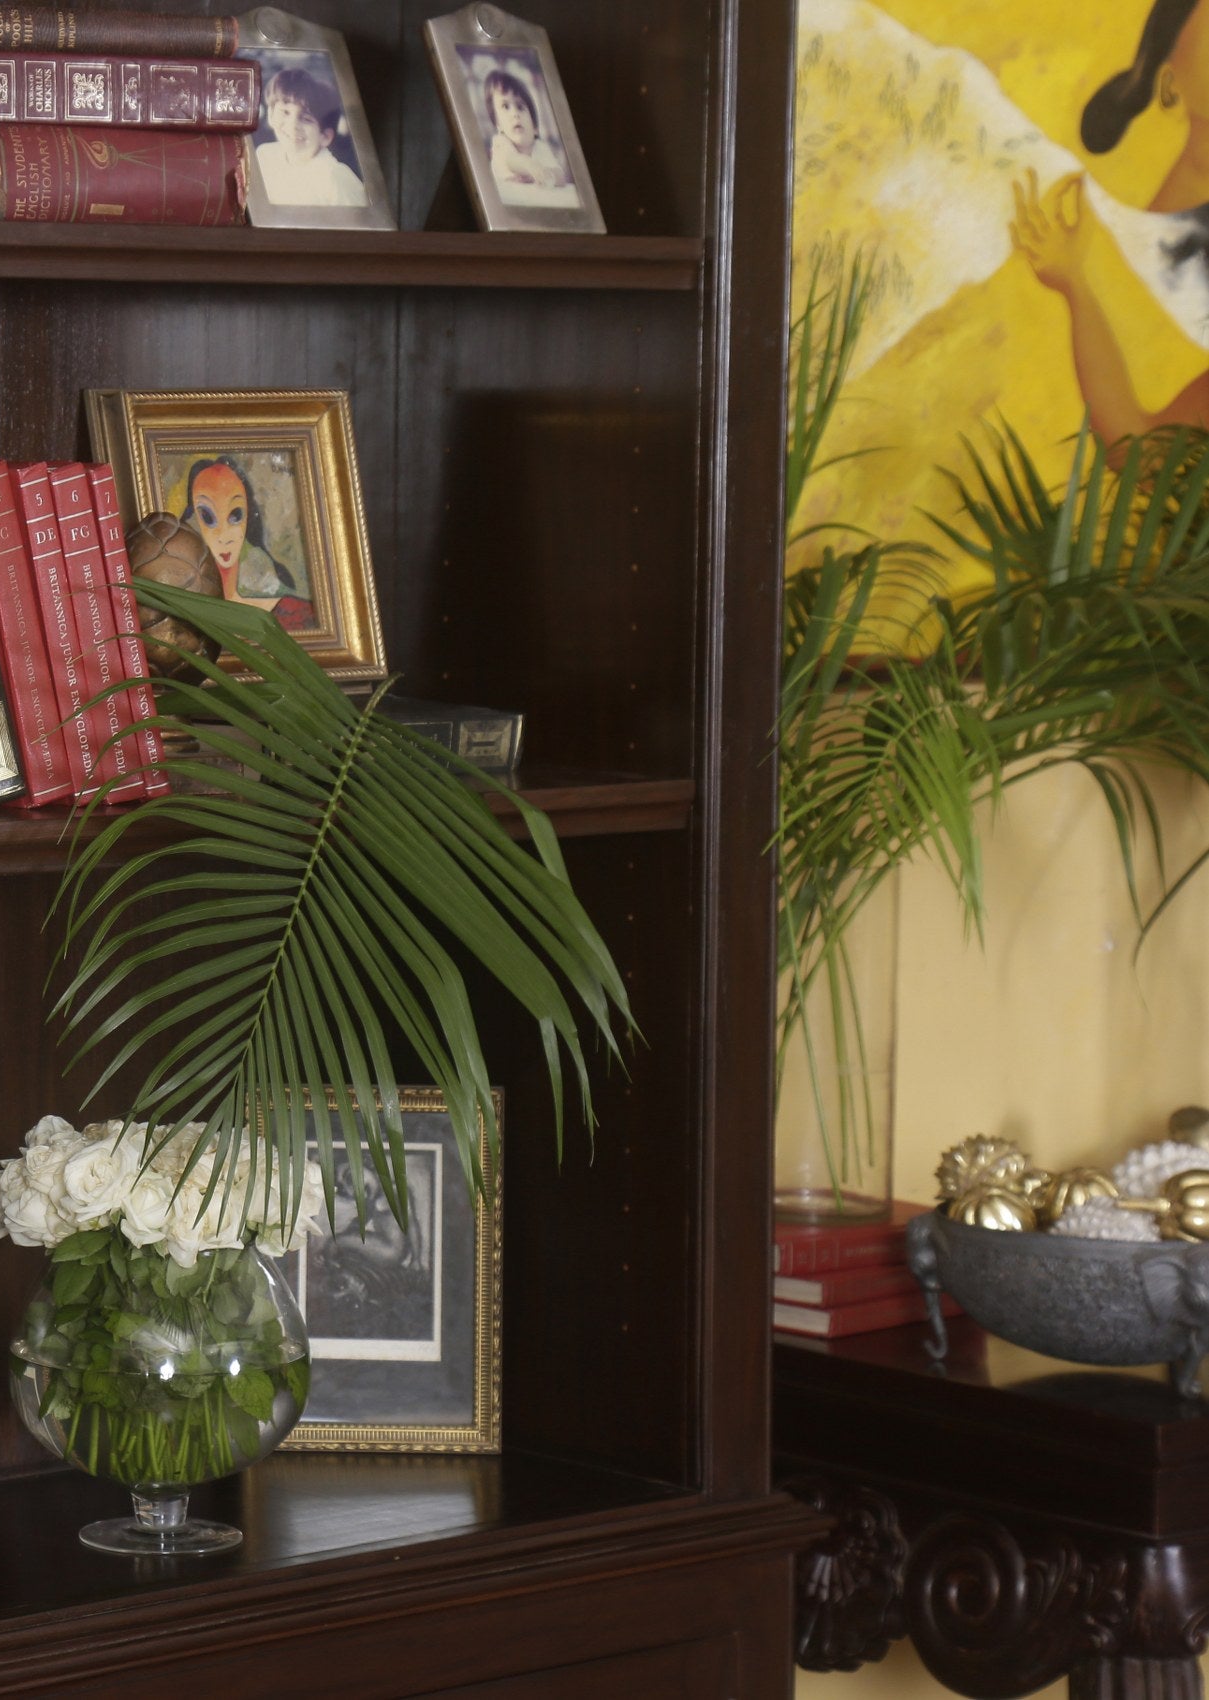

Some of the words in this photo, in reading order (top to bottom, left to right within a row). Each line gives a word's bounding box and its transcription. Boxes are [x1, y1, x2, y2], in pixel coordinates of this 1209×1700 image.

[24, 14, 33, 43] HILL
[57, 11, 66, 49] RUDYARD
[68, 13, 76, 48] KIPLING
[35, 68, 43, 112] CHARLES
[44, 68, 52, 112] DICKENS
[26, 163, 40, 220] ENGLISH
[37, 136, 52, 220] DICTIONARY
[13, 197, 27, 218] THE
[35, 492, 43, 506] 5
[71, 489, 79, 502] 6
[104, 491, 111, 503] 7
[0, 526, 9, 540] C
[35, 527, 57, 545] DE
[71, 525, 90, 541] FG
[109, 527, 120, 541] H
[7, 564, 27, 638] BRITANNICA
[21, 640, 36, 684] JUNIOR
[48, 566, 68, 640] BRITANNICA
[59, 642, 77, 687] JUNIOR
[83, 564, 102, 636] BRITANNICA
[93, 639, 110, 684] JUNIOR
